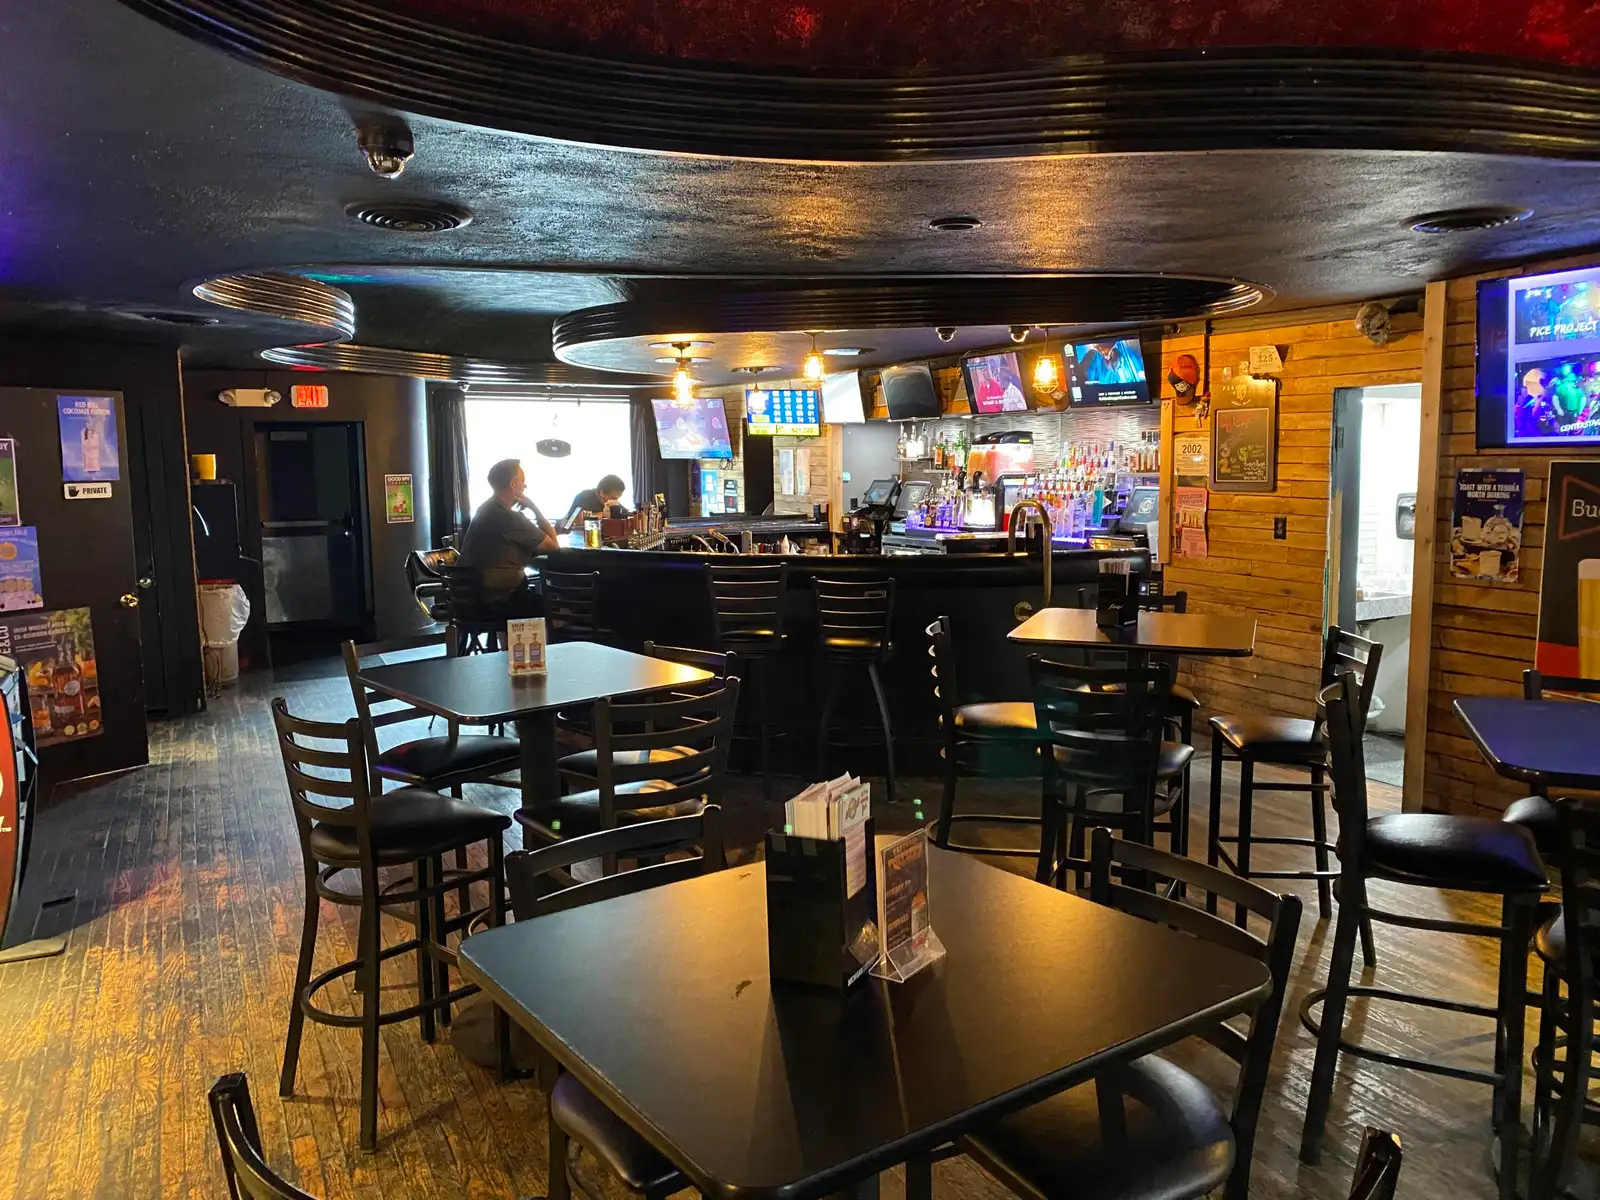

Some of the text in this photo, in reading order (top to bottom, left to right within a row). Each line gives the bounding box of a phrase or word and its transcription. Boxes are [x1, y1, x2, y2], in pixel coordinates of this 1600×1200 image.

[1553, 319, 1599, 336] PROJECT
[296, 385, 325, 406] EXIT
[1182, 444, 1202, 454] 2002
[1459, 483, 1476, 491] TOAST
[1497, 484, 1520, 492] TEQUILA
[1572, 498, 1600, 518] Bu
